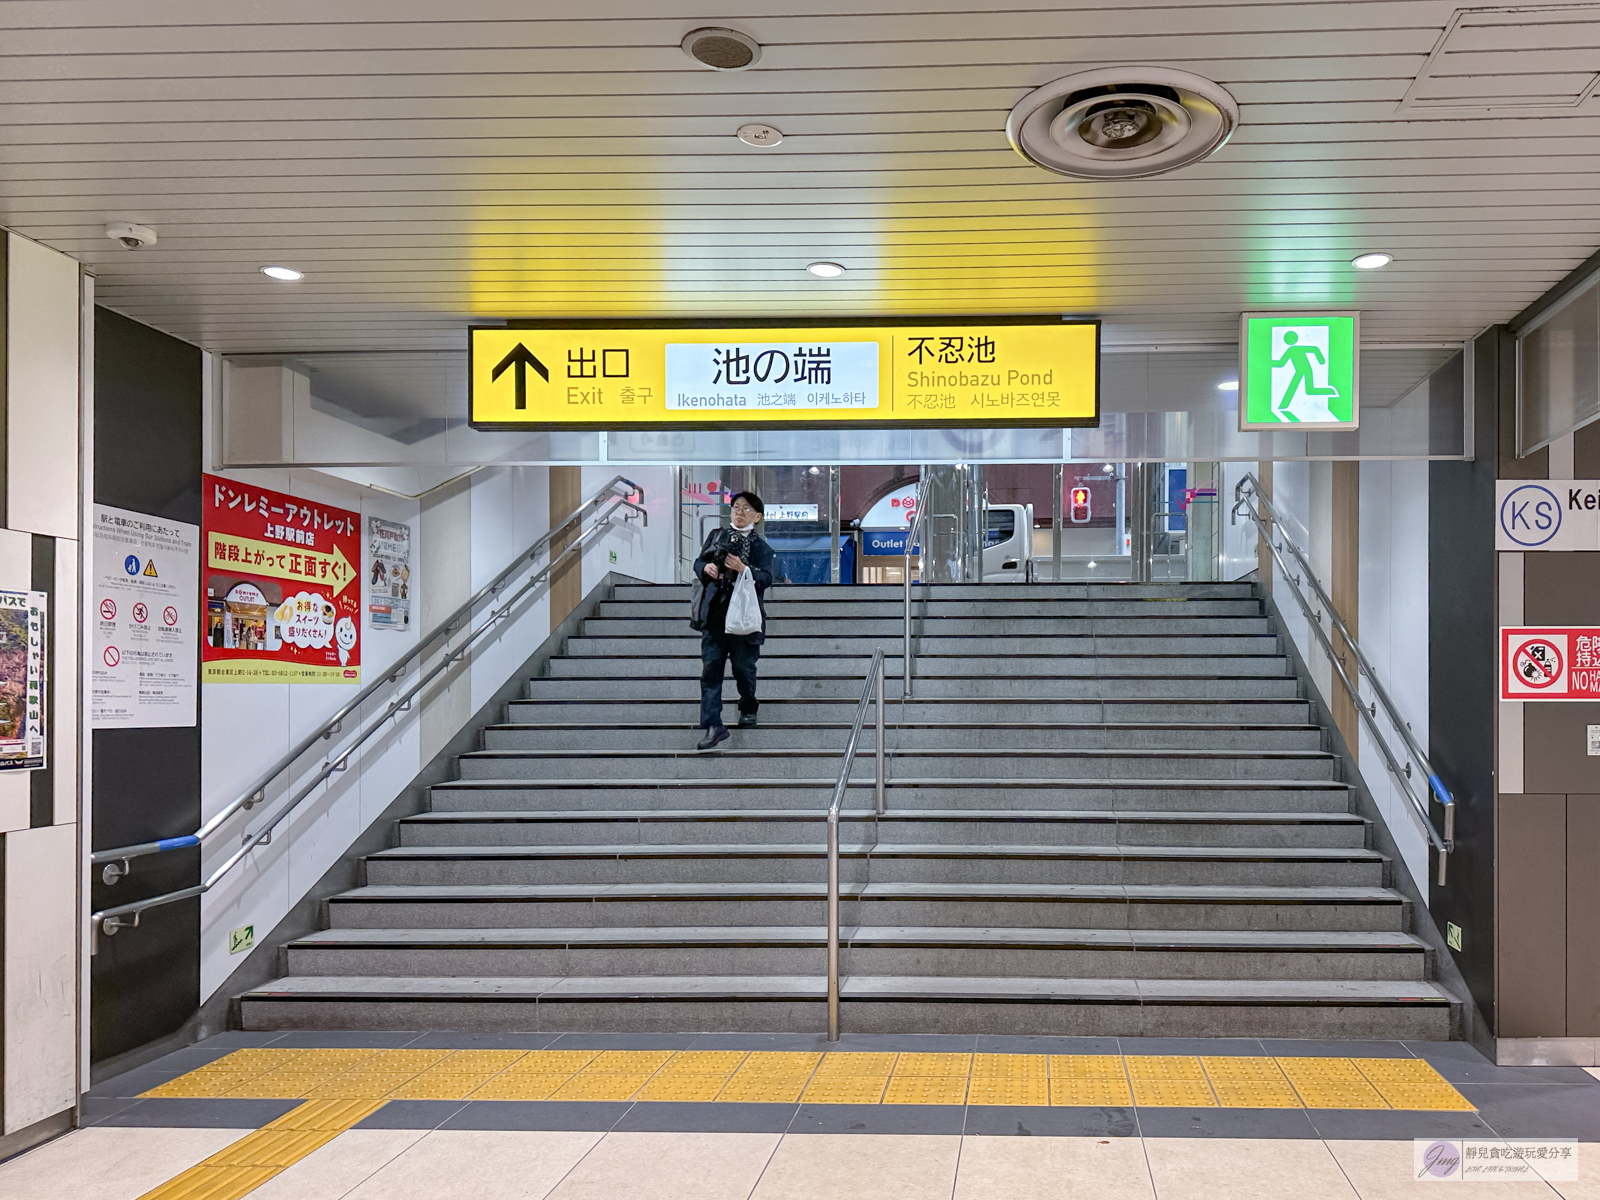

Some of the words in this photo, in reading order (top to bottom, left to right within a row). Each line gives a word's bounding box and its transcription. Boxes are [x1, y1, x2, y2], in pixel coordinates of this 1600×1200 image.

[907, 335, 996, 365] 不忍池
[567, 347, 630, 378] 出口
[712, 346, 832, 386] 池の端
[907, 371, 1001, 388] Shinobazu
[1007, 369, 1053, 387] Pond
[567, 386, 603, 405] Exit
[619, 386, 654, 405] 출구
[677, 392, 747, 407] Ikenohata
[757, 392, 797, 406] 池之端
[806, 392, 866, 406] 이케노하타
[907, 393, 956, 410] 不忍池
[970, 391, 1061, 409] 시노바즈연못
[214, 483, 355, 537] ドンレミーアウトレット
[1511, 501, 1553, 530] KS
[264, 522, 315, 547] 上野駅前店
[871, 539, 904, 549] Outlet
[296, 601, 319, 613] お得な
[295, 614, 320, 626] スイーツ
[1572, 671, 1589, 690] NO
